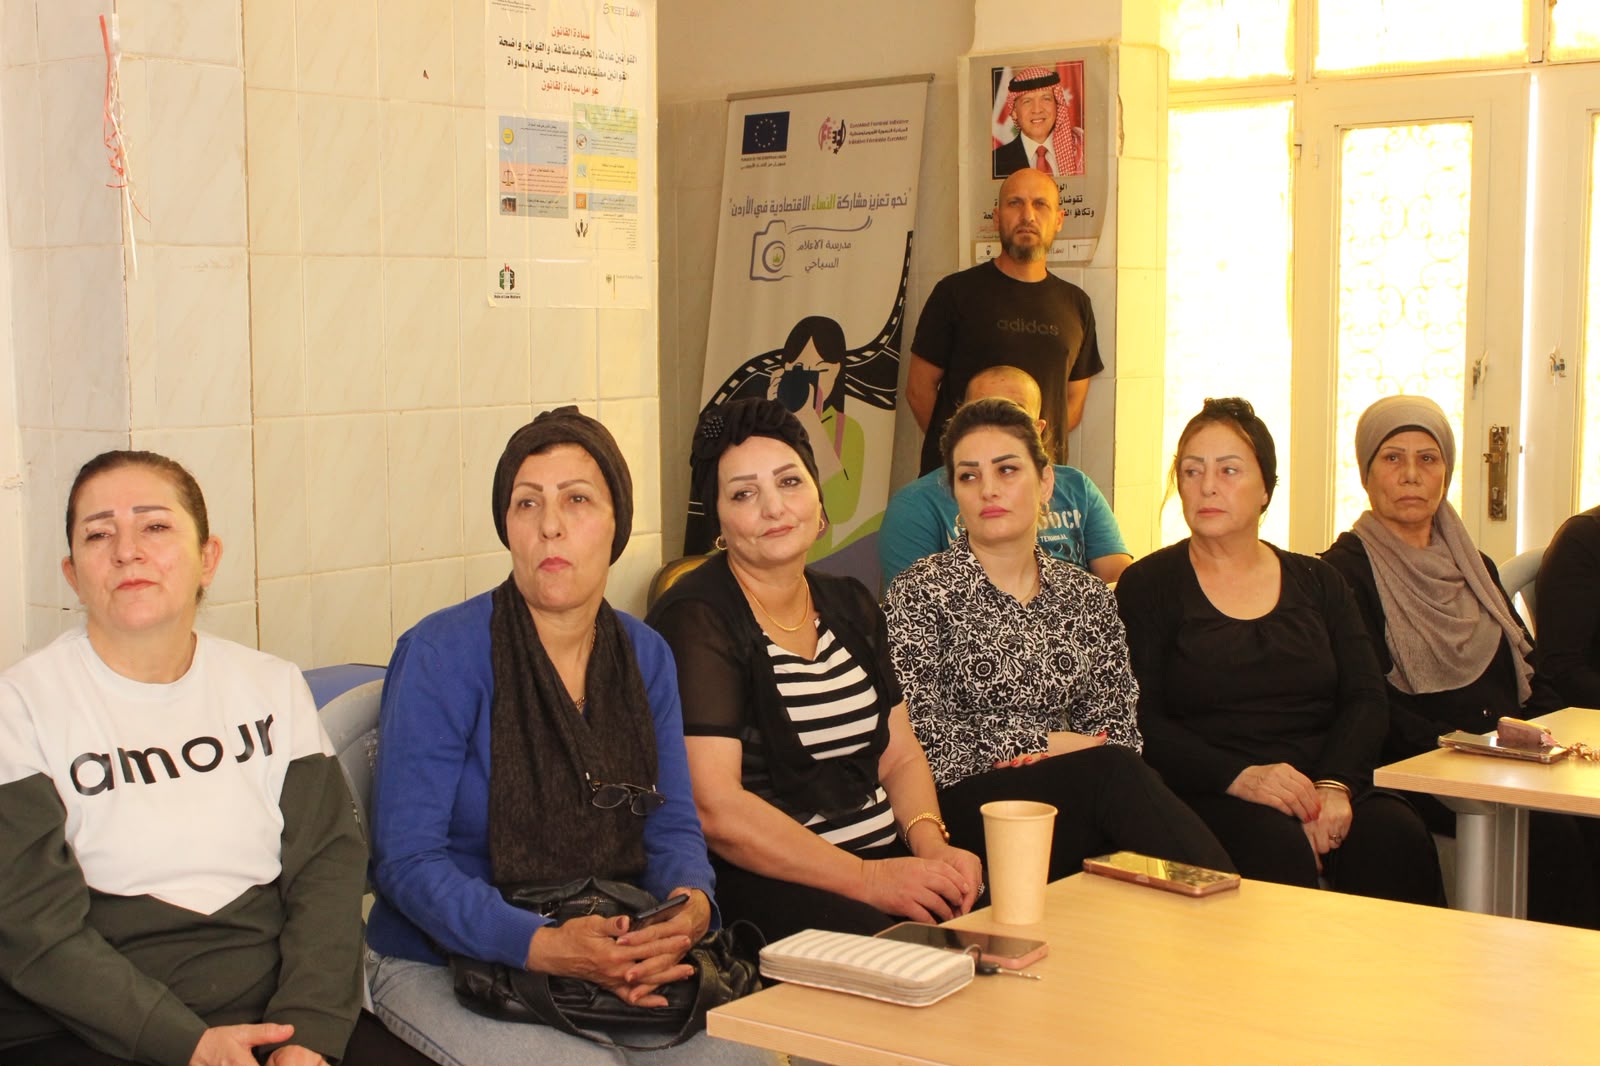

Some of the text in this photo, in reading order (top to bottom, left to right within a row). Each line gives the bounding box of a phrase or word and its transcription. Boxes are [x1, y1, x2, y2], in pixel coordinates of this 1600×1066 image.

[499, 36, 522, 51] واضحة
[753, 200, 769, 218] في
[769, 195, 811, 216] الاقتصادية
[811, 193, 837, 211] النساء
[837, 191, 868, 212] مشاركة
[868, 193, 890, 211] تعزيز
[826, 240, 852, 252] مدرسة
[804, 257, 840, 273] السياحي
[996, 317, 1059, 336] adidas
